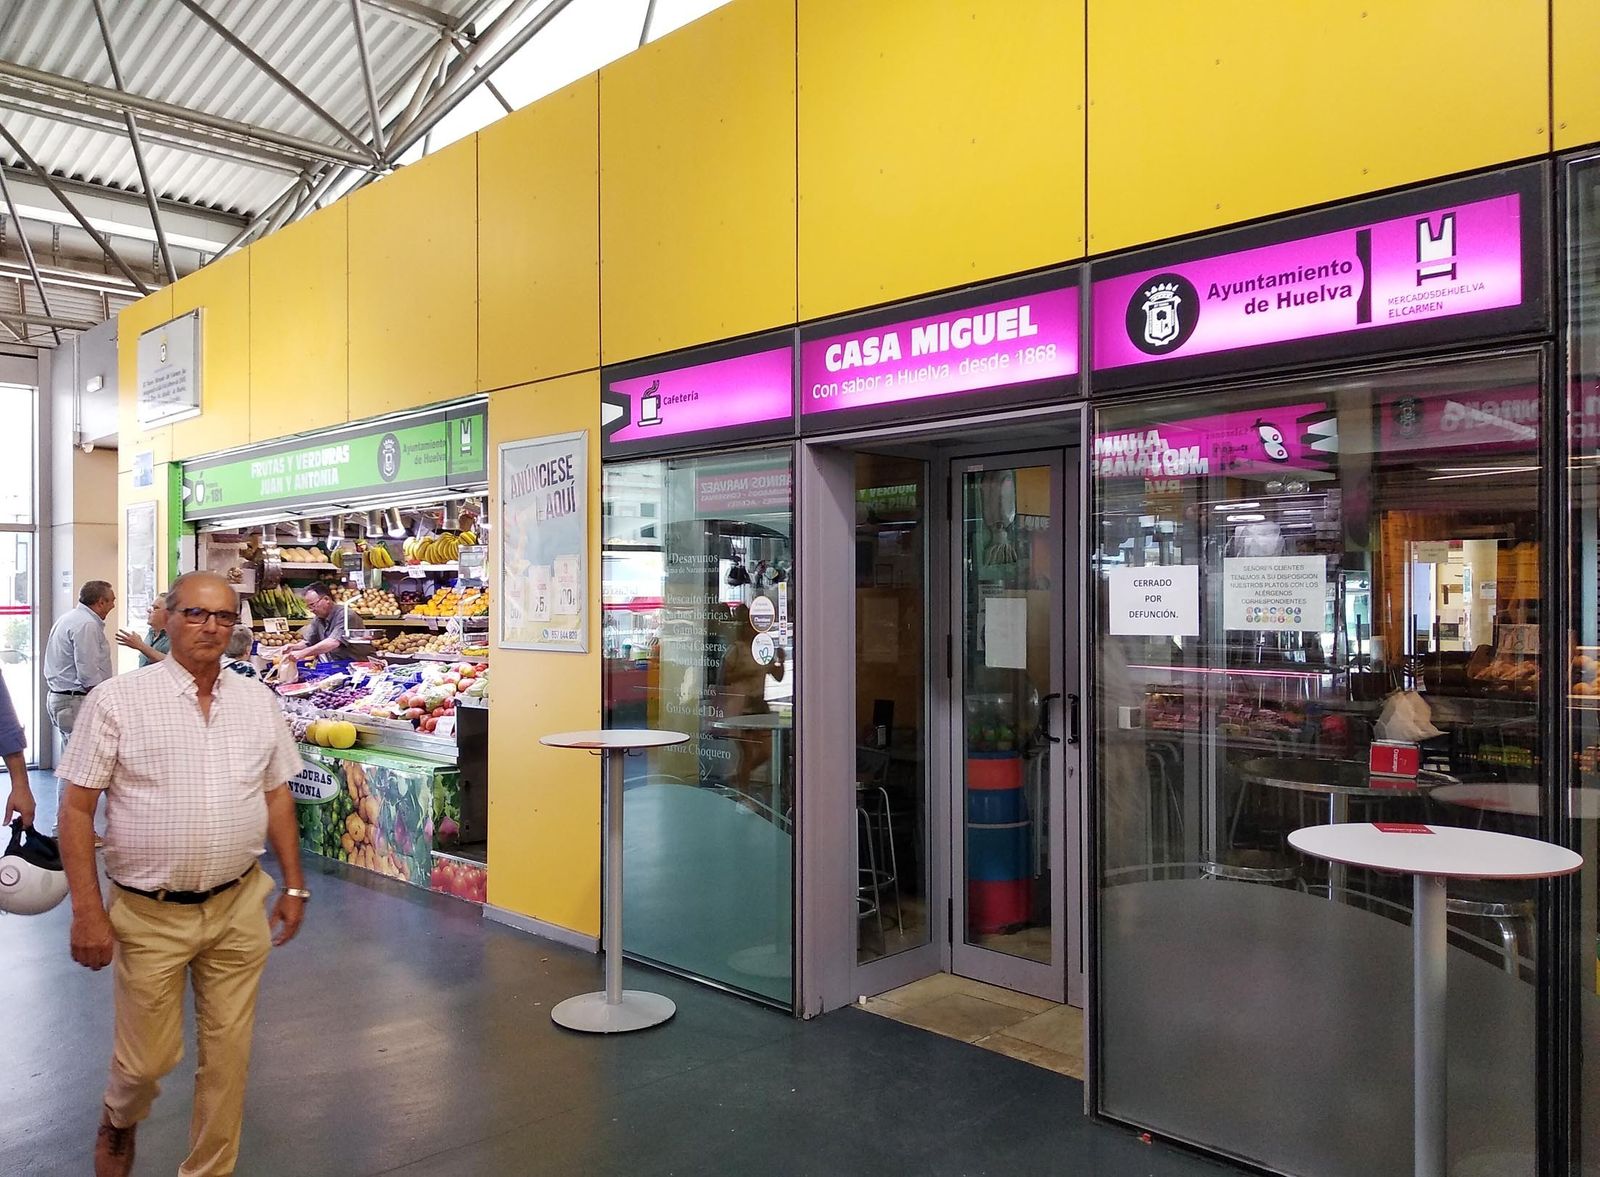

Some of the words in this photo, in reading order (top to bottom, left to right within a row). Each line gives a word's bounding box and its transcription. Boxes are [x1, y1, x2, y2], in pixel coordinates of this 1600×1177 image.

[1207, 258, 1353, 301] Ayuntamiento
[1244, 295, 1268, 315] de
[1276, 283, 1353, 312] Huelva
[824, 334, 902, 372] CASA
[911, 305, 1038, 358] MIGUEL
[812, 381, 839, 400] Con
[842, 371, 881, 395] sabor
[884, 375, 894, 387] a
[959, 352, 1010, 375] desde
[1015, 343, 1057, 366] 1868
[663, 389, 699, 406] Cafetería
[251, 457, 285, 479] FRUTAS
[287, 455, 295, 472] Y
[296, 444, 350, 470] VERDURAS
[260, 476, 284, 496] JUAN
[285, 475, 293, 493] Y
[294, 468, 340, 491] ANTONIA
[510, 453, 574, 500] ANÚNCIESE
[546, 480, 576, 520] AQUÍ
[672, 553, 718, 566] Desayunos
[1133, 578, 1172, 588] CERRADO
[705, 593, 722, 604] frit
[1144, 594, 1162, 603] POR
[693, 608, 729, 620] ibéricas
[1128, 608, 1179, 619] DEFUNCIÓN.
[708, 706, 724, 718] Día
[688, 744, 731, 760] Choquero
[287, 781, 322, 798] NTONIA
